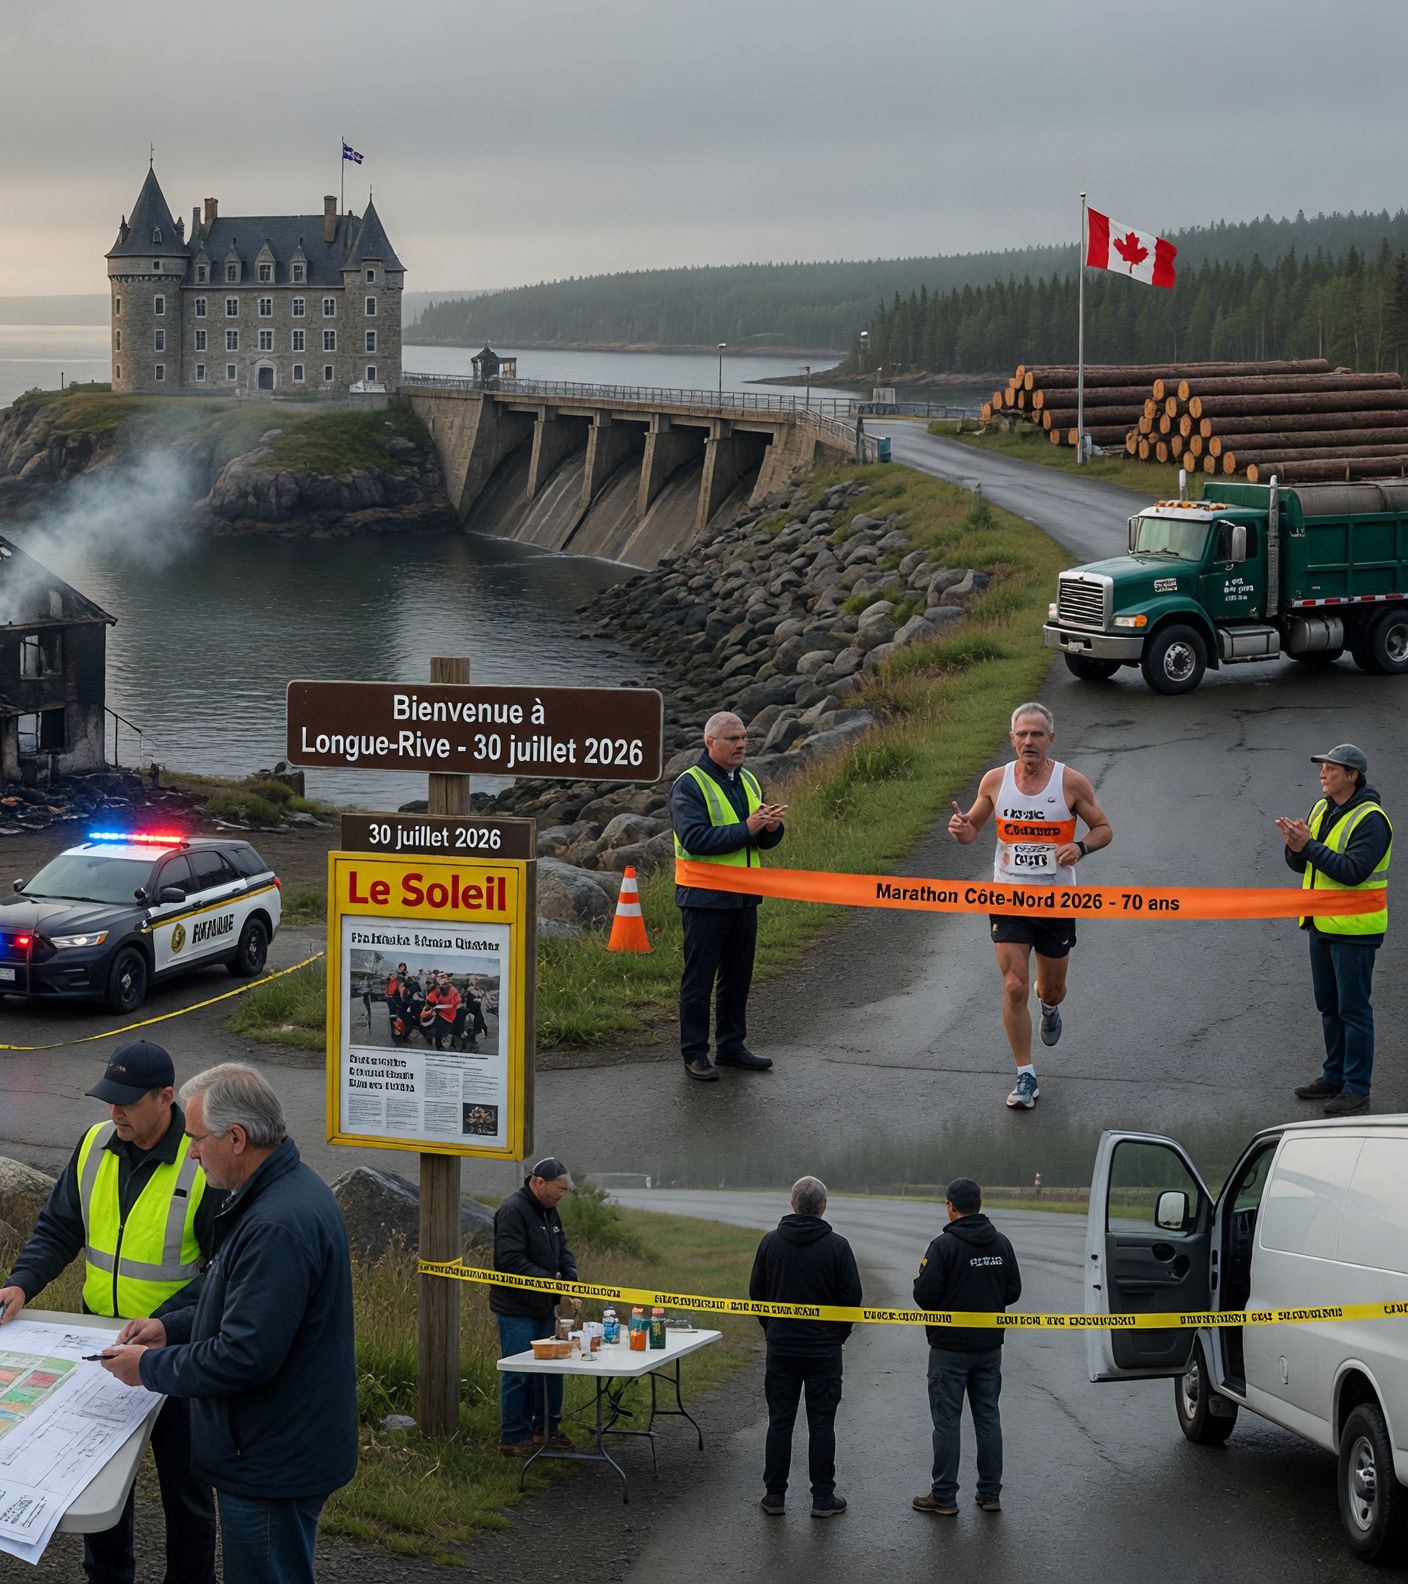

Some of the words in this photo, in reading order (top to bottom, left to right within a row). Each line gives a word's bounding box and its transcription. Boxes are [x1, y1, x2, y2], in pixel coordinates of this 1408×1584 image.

[393, 694, 524, 725] Bienvenue
[530, 697, 545, 725] à
[301, 726, 451, 762] Longue-Rive
[473, 733, 502, 761] 30
[507, 734, 577, 769] juillet
[584, 737, 643, 767] 2026
[368, 823, 391, 845] 30
[395, 825, 450, 850] juillet
[455, 827, 501, 850] 2026
[348, 871, 391, 906] Le
[401, 872, 506, 912] Soleil
[876, 882, 958, 903] Marathon
[964, 888, 1055, 908] Côte-Nord
[1060, 892, 1103, 910] 2026
[1121, 894, 1143, 910] 70
[1148, 898, 1180, 911] ans
